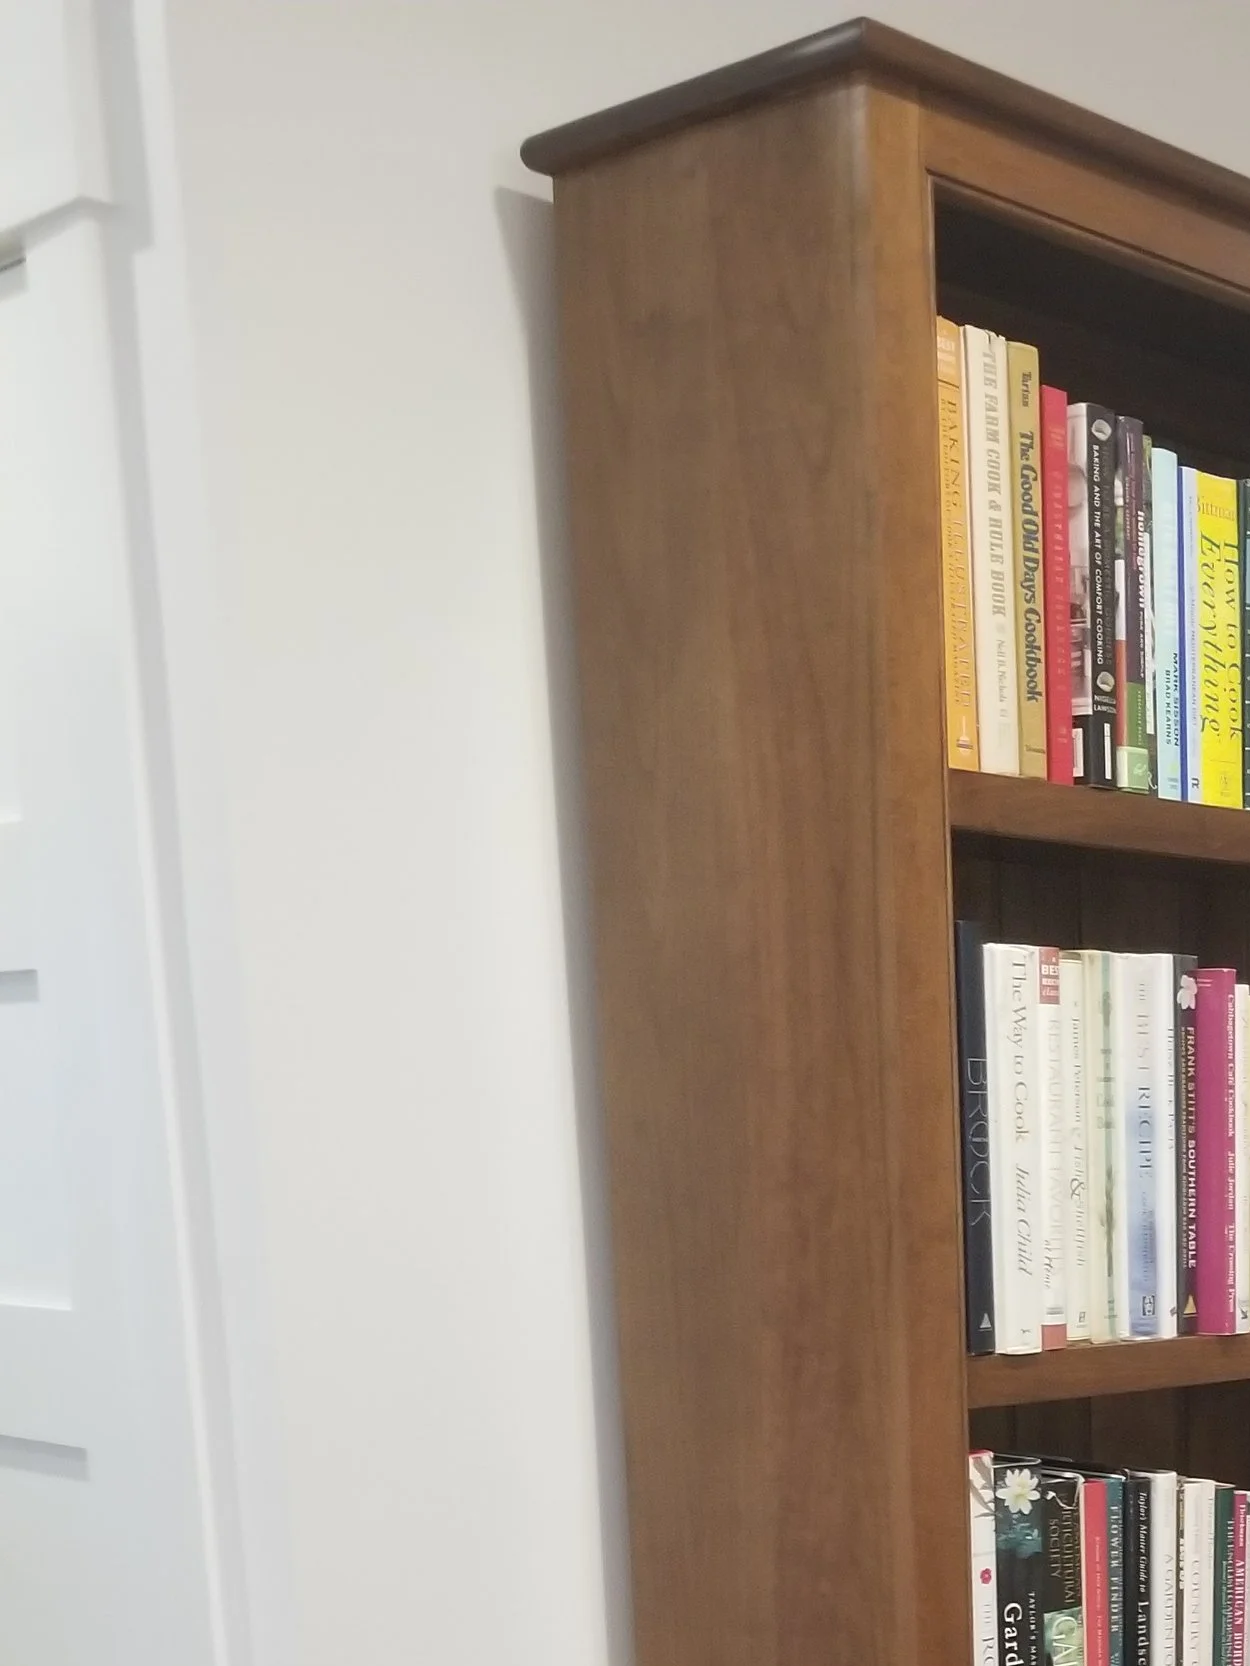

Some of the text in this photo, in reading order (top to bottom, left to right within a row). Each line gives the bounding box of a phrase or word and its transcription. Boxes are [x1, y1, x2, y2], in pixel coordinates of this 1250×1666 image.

[947, 400, 961, 508] BAKING
[983, 351, 1006, 618] THE FARM COOK & RULE BOOK
[1019, 430, 1044, 703] The Good Old Days Cookbook
[1092, 444, 1105, 666] BAKING AND THE ART OF COMFORT COOKING
[1137, 510, 1146, 608] homegrown
[1199, 531, 1227, 733] Everything
[1224, 540, 1242, 740] How to Cook
[1164, 669, 1173, 745] BRAD KEARNS
[1173, 697, 1181, 747] SISSON
[1006, 955, 1030, 1144] The Way to Cook
[1136, 1013, 1151, 1071] BEST
[1226, 993, 1236, 1060] Cabbagetown
[1048, 1019, 1063, 1158] RESTAURANT
[1137, 1086, 1153, 1179] RECIPE
[1226, 1089, 1236, 1137] Cookbook
[967, 1057, 991, 1227] BROCK
[1073, 1146, 1085, 1178] Fish
[1187, 1026, 1198, 1268] FRANK STITT'S SOUTHERN TABLE
[1227, 1150, 1236, 1210] Julie Jordan
[1015, 1162, 1033, 1277] Julia Child
[1070, 1178, 1086, 1200] &
[1227, 1224, 1236, 1242] The
[1048, 1518, 1062, 1579] SOCIETY
[1110, 1504, 1121, 1633] FLOWER FINDER
[1138, 1491, 1148, 1593] Taylor's Master Guide to
[1165, 1554, 1174, 1565] A
[1028, 1591, 1039, 1640] TAYLOR'S
[1164, 1568, 1175, 1641] GARDEN
[1190, 1559, 1201, 1651] COUNTRY
[1233, 1558, 1246, 1626] AMERICAN
